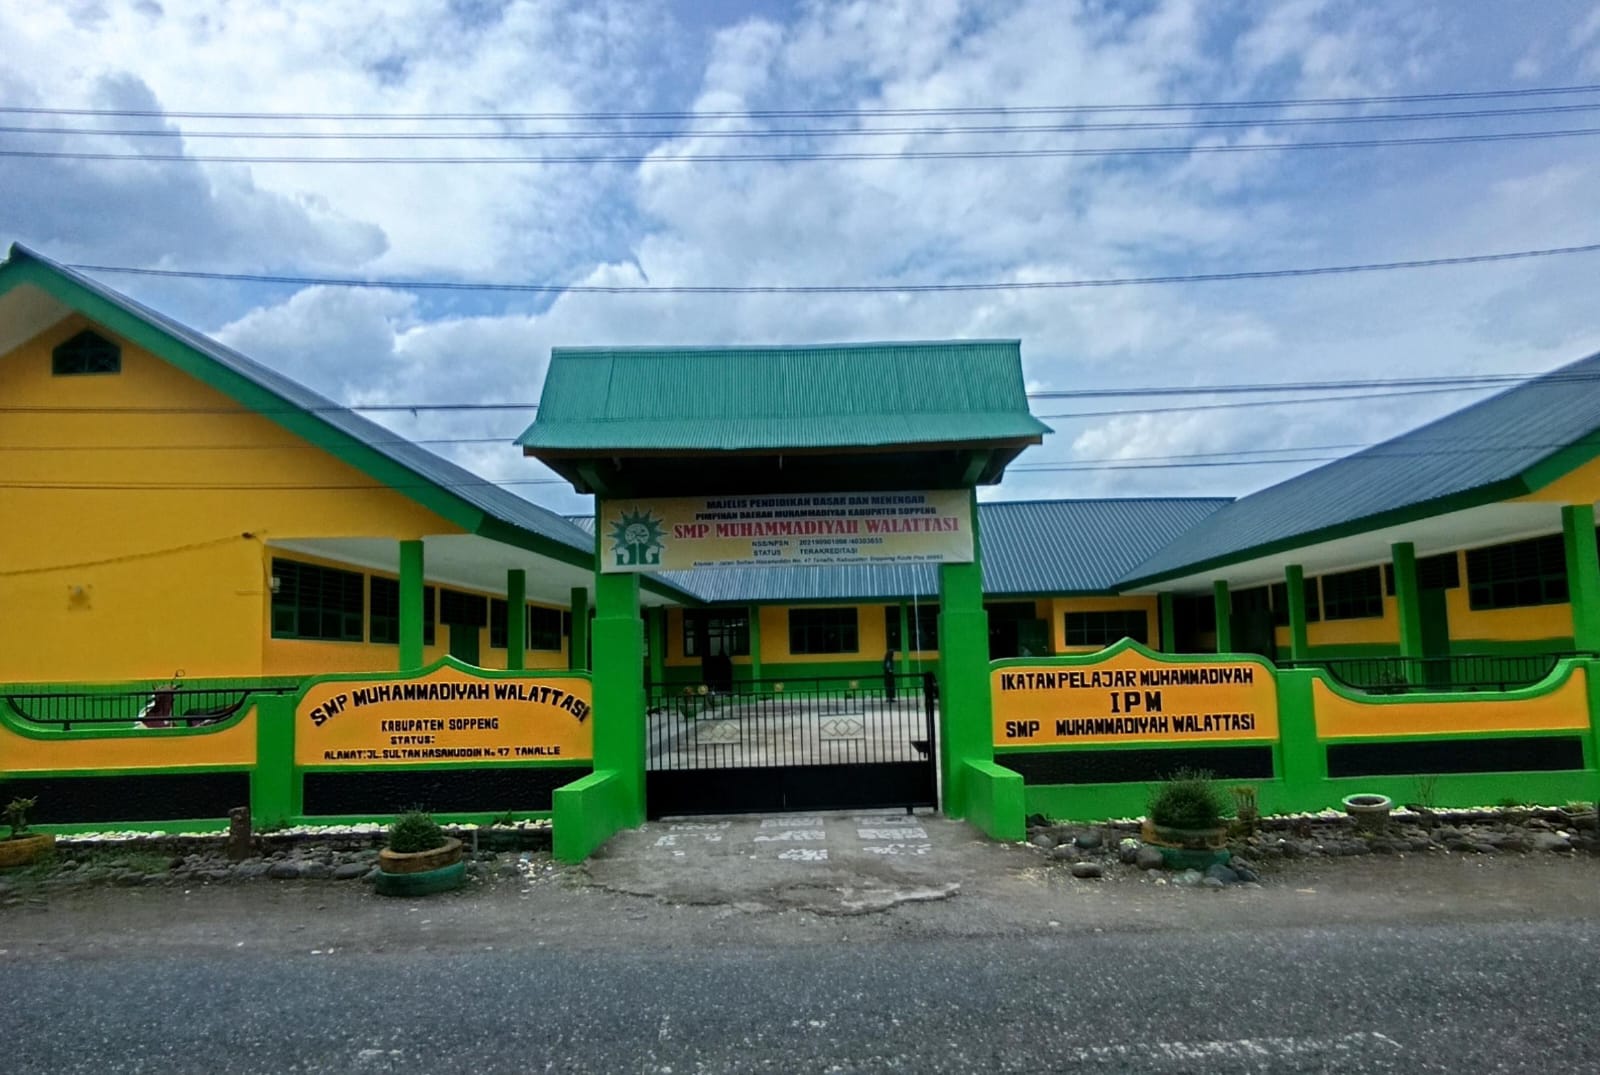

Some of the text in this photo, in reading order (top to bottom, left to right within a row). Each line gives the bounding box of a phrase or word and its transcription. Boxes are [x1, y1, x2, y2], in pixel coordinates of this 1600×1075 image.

[707, 498, 747, 509] MAJELIS
[750, 496, 810, 508] PENDIDIKAN
[813, 496, 845, 506] DASAR
[848, 496, 869, 505] DAN
[696, 507, 937, 521] PIMPINAN DAERAH MUHAMMADIYAH KABUPATEN SOPPENG
[674, 517, 959, 539] SMP MUHAMMADIYAH WALATTASI
[1001, 667, 1253, 691] IKATAN PELAJAR MUHAMMADIYAH
[310, 683, 591, 727] SMP MUHAMMADIYAH WALATTASI
[381, 718, 499, 732] KABUPATEN SOPPENG
[1006, 713, 1255, 738] SMP MUHAMMADIYAH WALATTASI
[390, 735, 436, 745] STATUS:
[498, 747, 510, 755] 47
[515, 746, 560, 755] TANALLE
